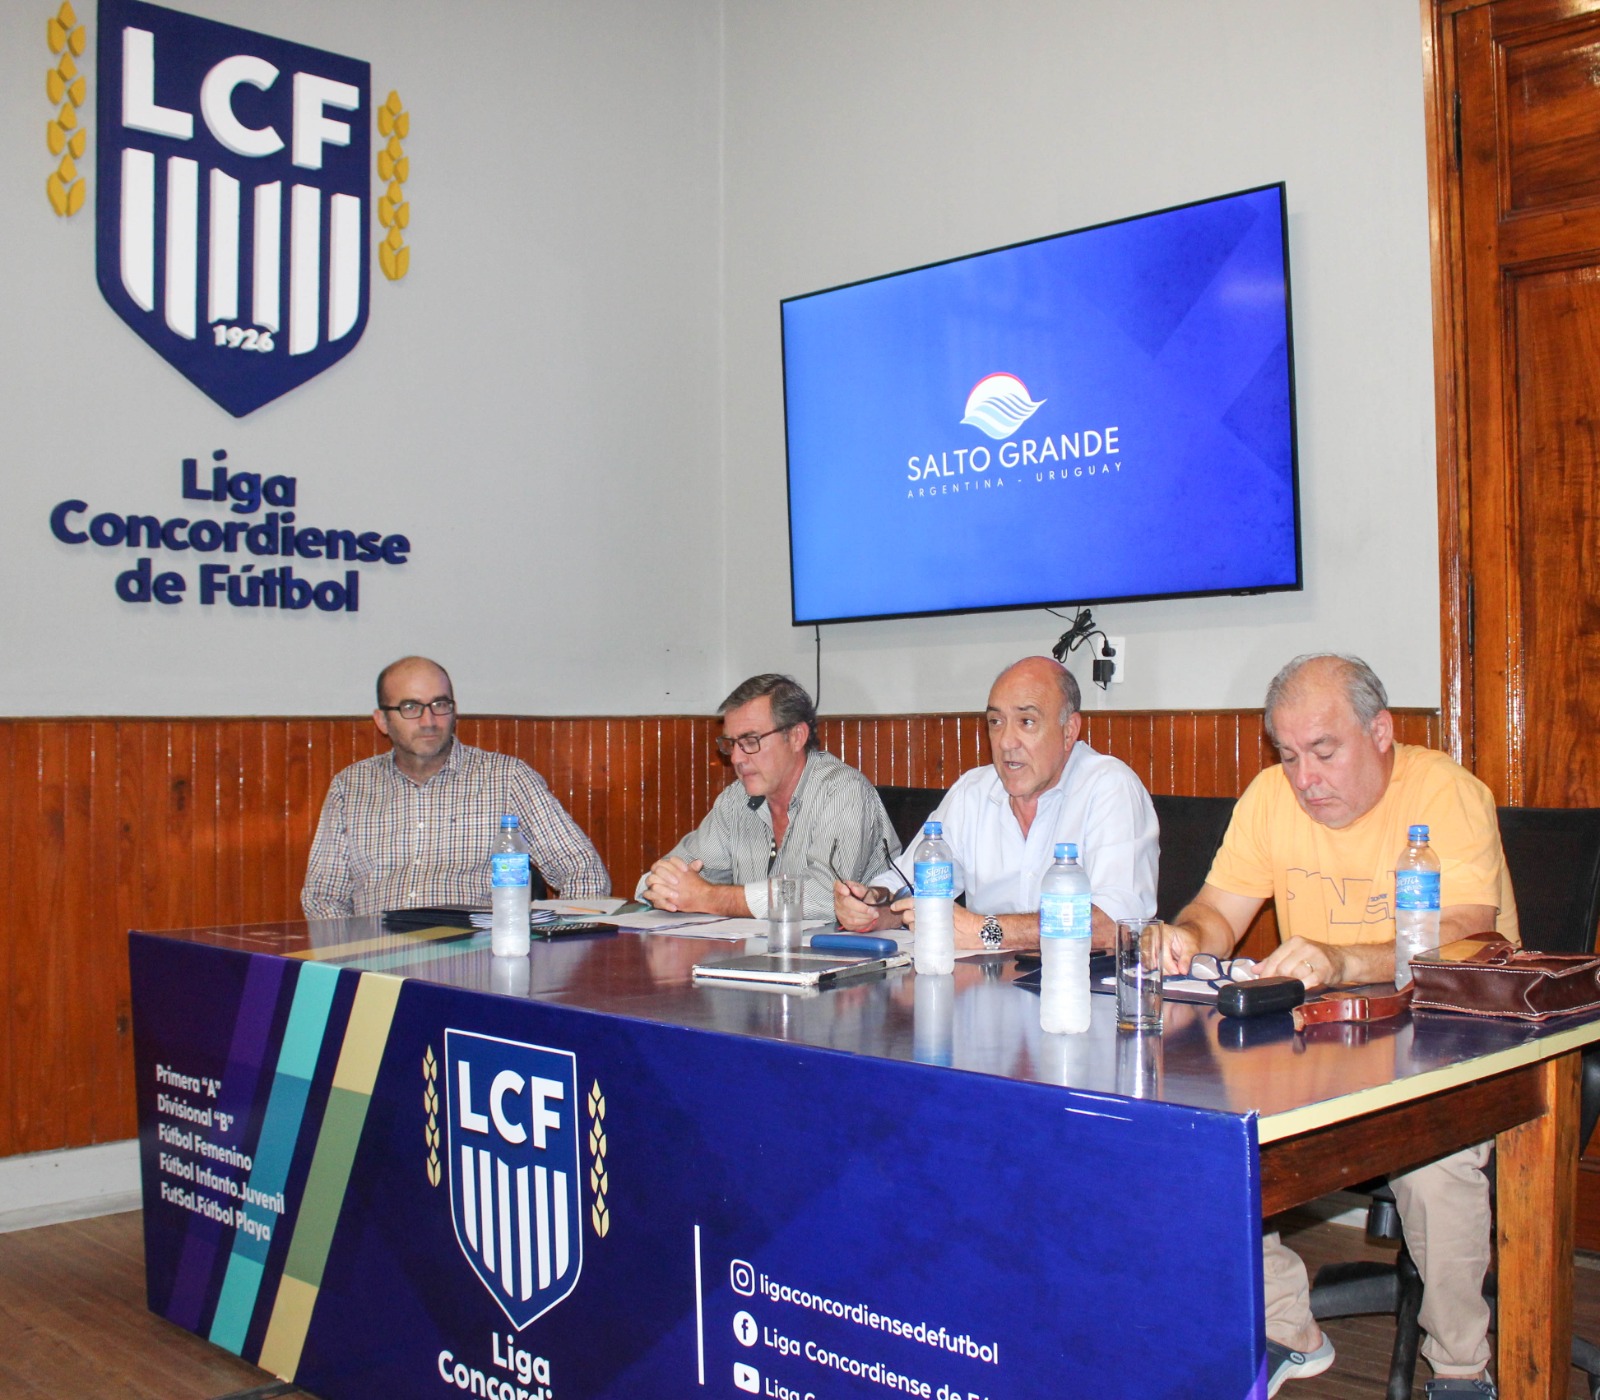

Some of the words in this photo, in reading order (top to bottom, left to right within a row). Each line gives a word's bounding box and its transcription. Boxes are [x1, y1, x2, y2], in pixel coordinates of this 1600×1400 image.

[121, 26, 360, 170] LCF
[212, 324, 275, 353] 1926
[907, 446, 991, 481] SALTO
[998, 426, 1120, 468] GRANDE
[907, 478, 1004, 499] ARGENTINA
[1036, 461, 1122, 482] URUGUAY
[181, 448, 297, 514] Liga
[49, 500, 411, 565] Concordiense
[115, 558, 187, 605] de
[200, 564, 360, 612] Fútbol
[156, 1063, 200, 1093] Primera
[457, 1060, 565, 1150] LCF
[157, 1094, 212, 1127] Divisional
[158, 1123, 193, 1151] Fútbol
[194, 1135, 252, 1171] Femenino
[159, 1152, 194, 1181] Fútbol
[235, 1210, 271, 1241] Playa
[759, 1273, 999, 1365] ligaconcordiensedefutbol
[492, 1331, 551, 1385] Liga
[763, 1326, 801, 1356] Liga
[804, 1341, 932, 1399] Concordiense
